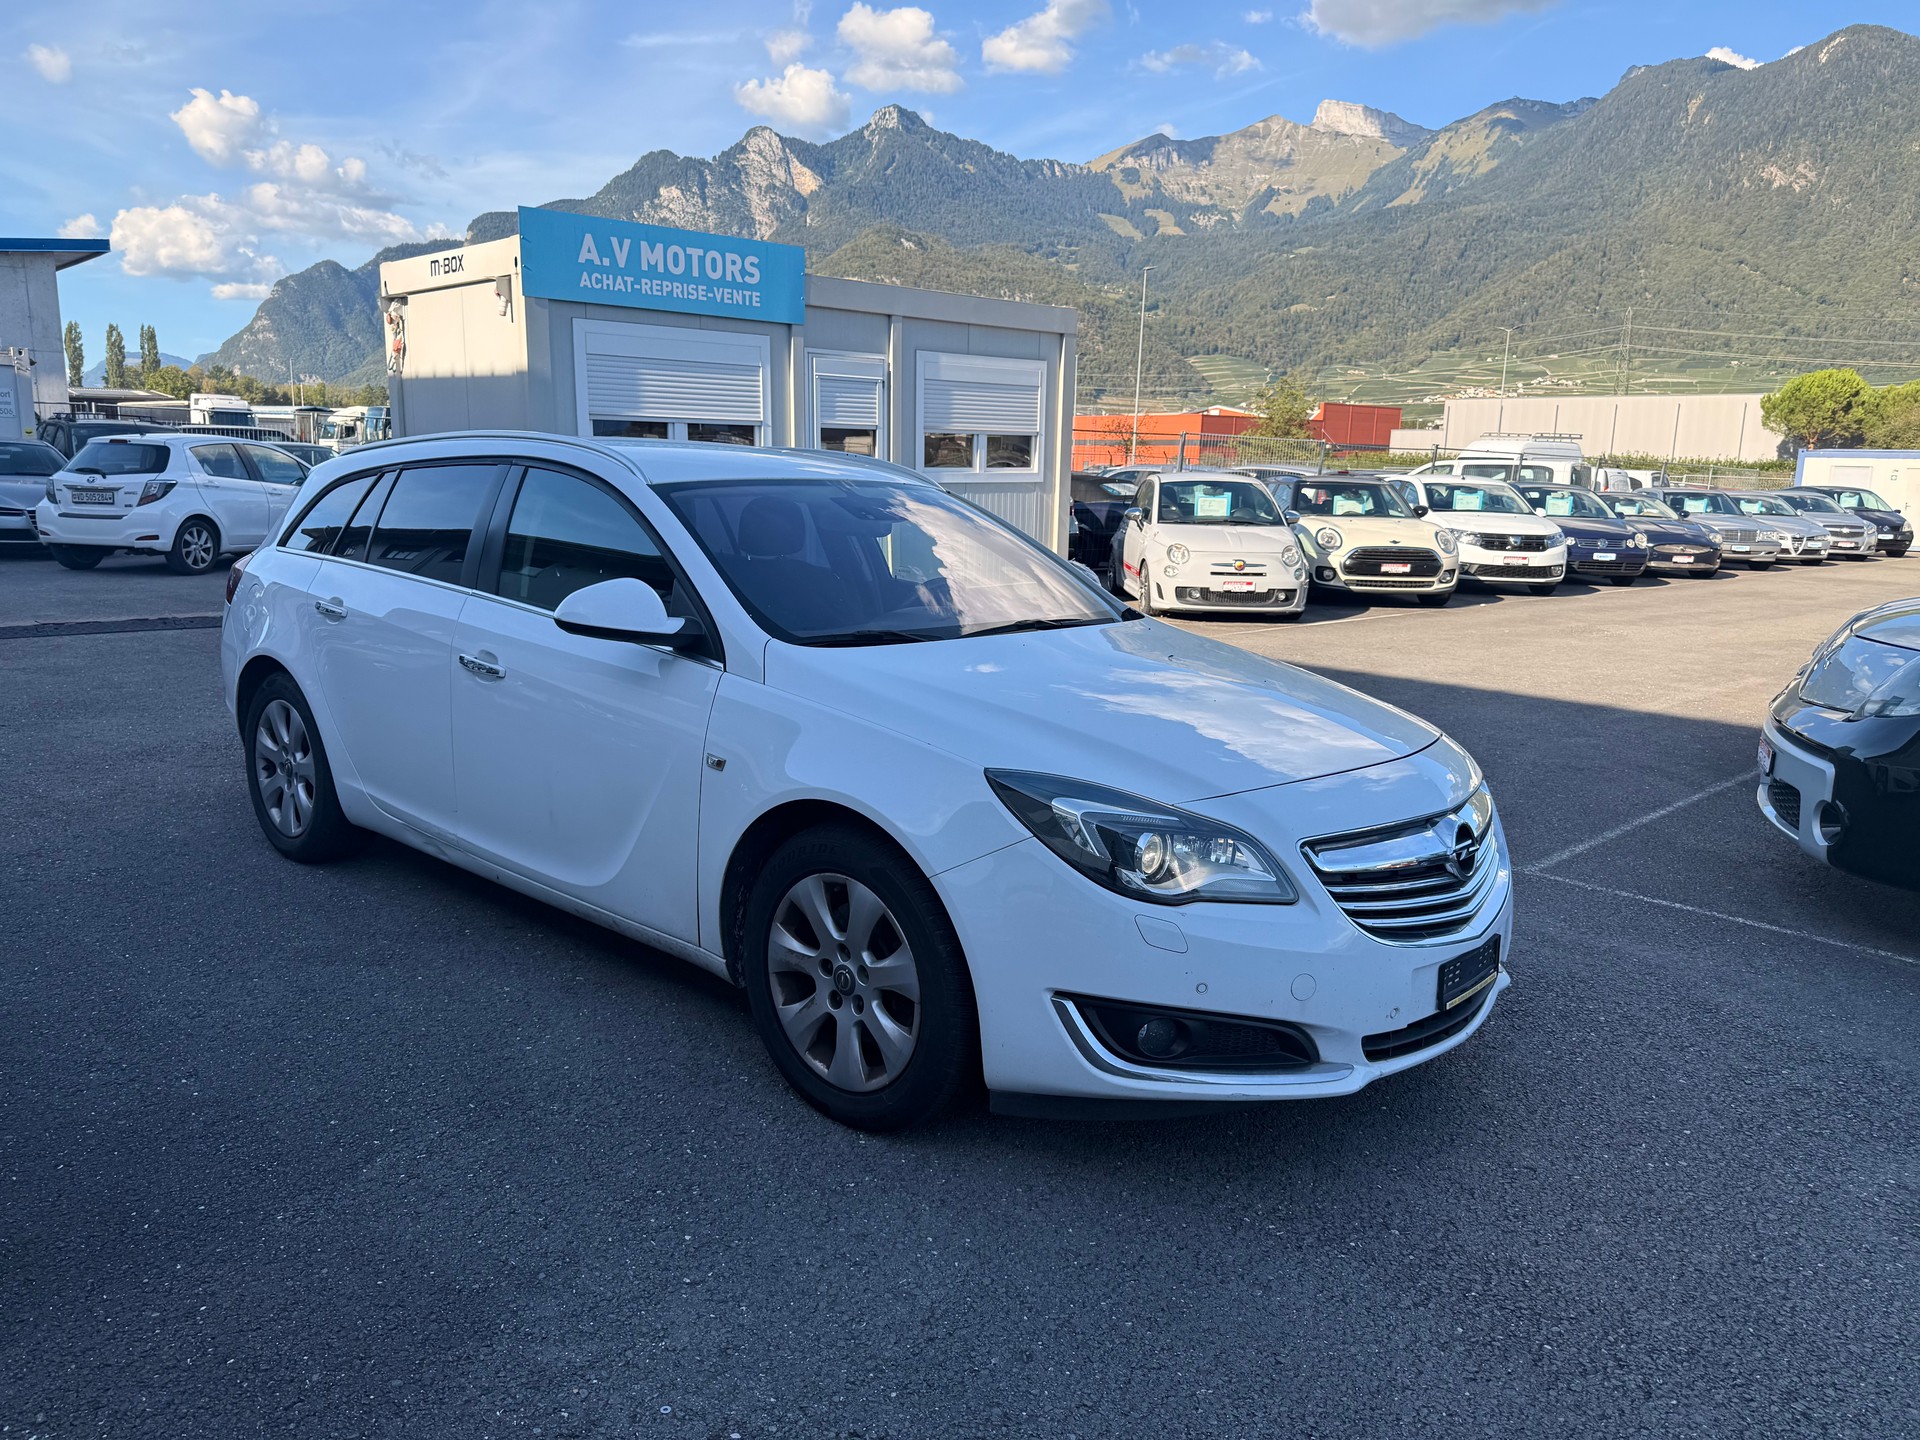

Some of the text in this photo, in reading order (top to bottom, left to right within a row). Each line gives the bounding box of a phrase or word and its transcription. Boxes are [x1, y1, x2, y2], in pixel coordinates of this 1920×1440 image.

[577, 233, 761, 285] A.V MOTORS
[579, 271, 761, 307] ACHAT-REPRISE-VENTE
